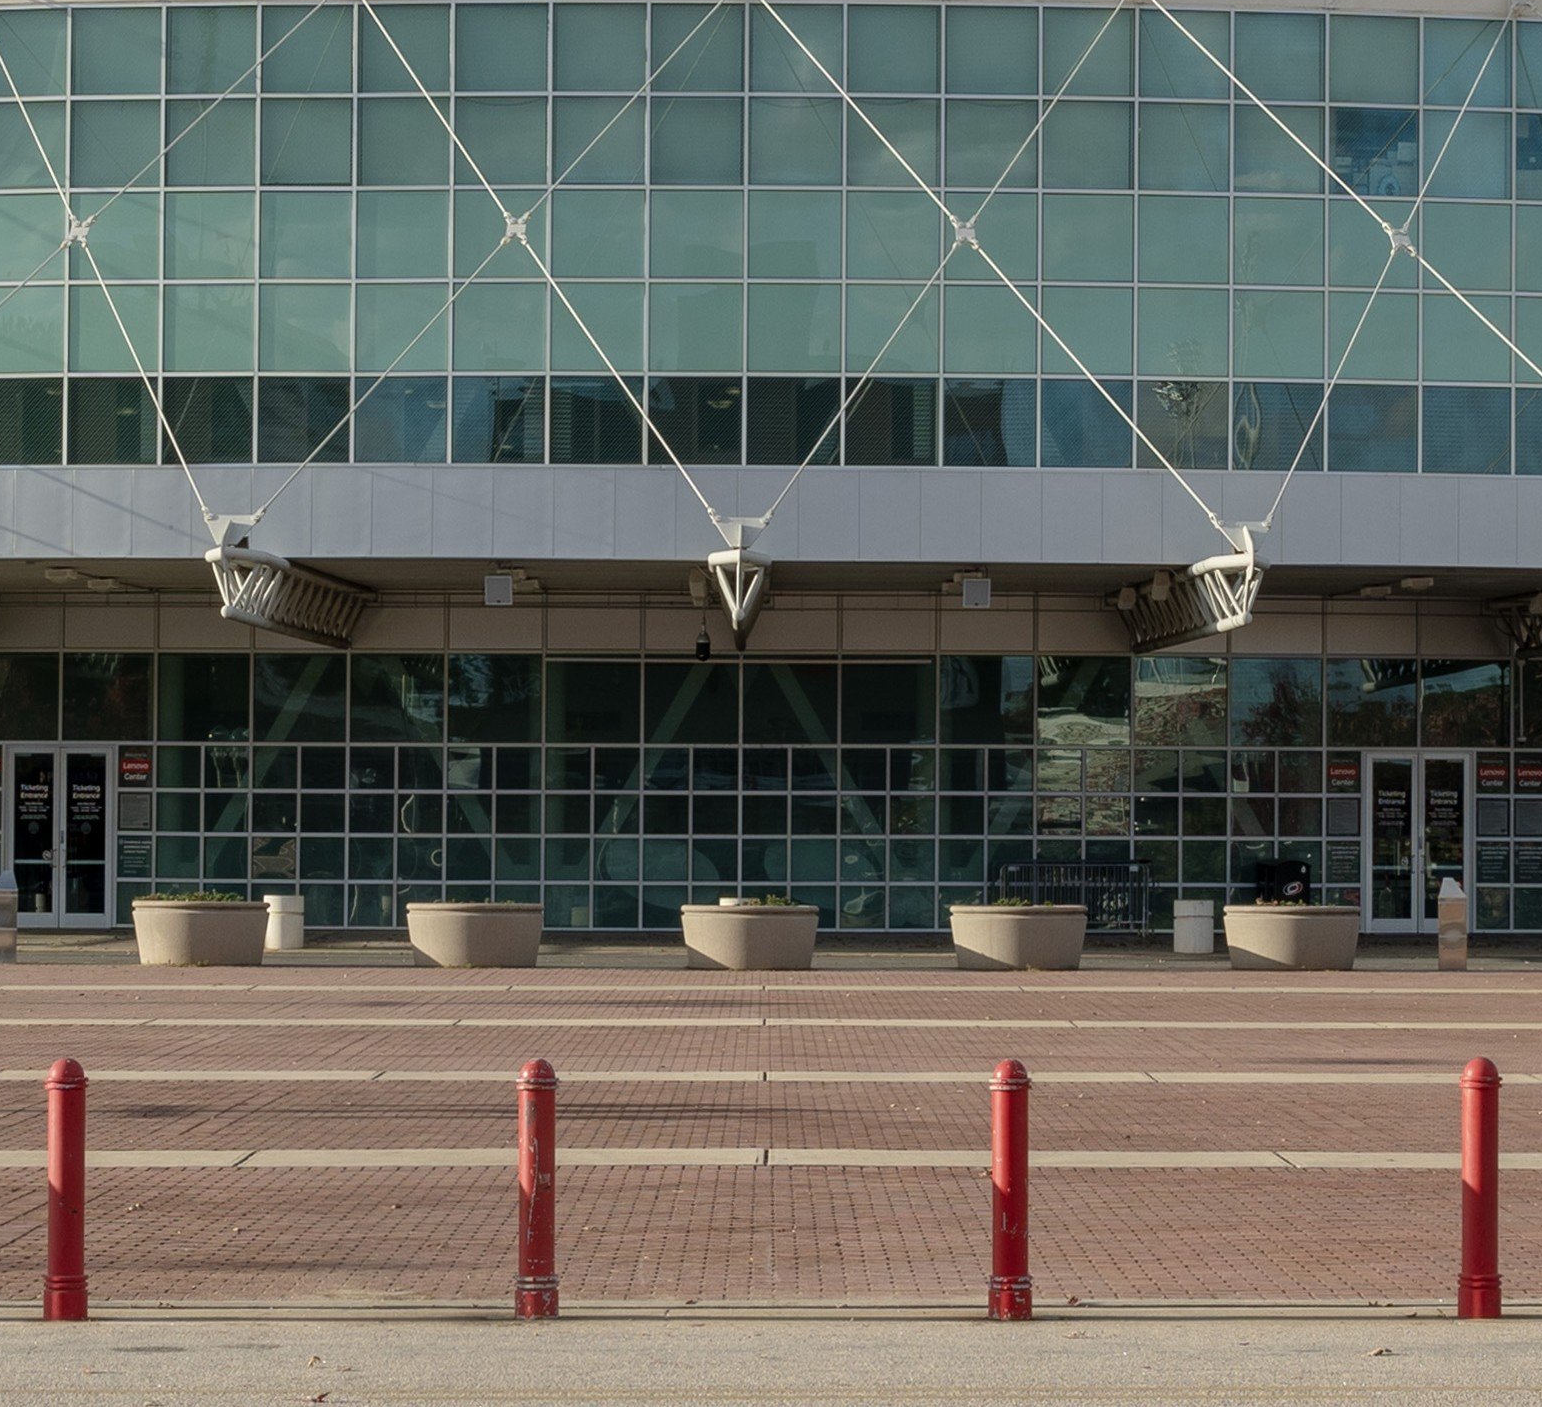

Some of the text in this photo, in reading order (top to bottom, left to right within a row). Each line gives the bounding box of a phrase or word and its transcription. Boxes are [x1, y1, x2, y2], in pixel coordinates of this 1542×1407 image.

[122, 762, 149, 770] Lenovo
[1330, 767, 1356, 776] Lenovo
[1479, 768, 1505, 777] Lenovo
[1517, 768, 1542, 777] Lenovo
[124, 772, 148, 781] Center
[1331, 778, 1355, 787] Center
[20, 784, 49, 793] Ticketing
[72, 784, 101, 793] Ticketing
[20, 792, 48, 800] Entrance
[72, 792, 101, 800] Entrance
[1378, 790, 1406, 799] Ticketing
